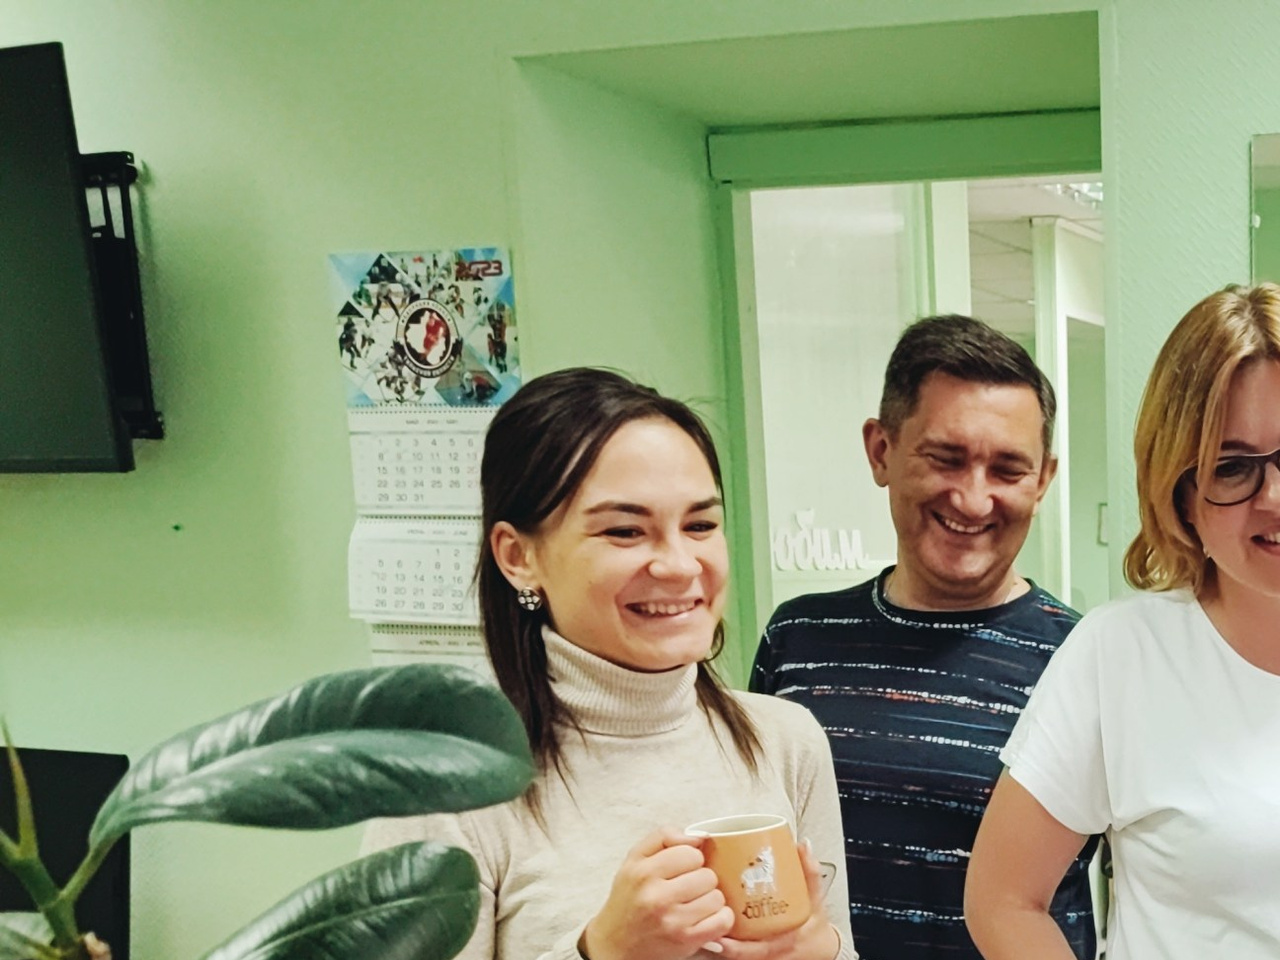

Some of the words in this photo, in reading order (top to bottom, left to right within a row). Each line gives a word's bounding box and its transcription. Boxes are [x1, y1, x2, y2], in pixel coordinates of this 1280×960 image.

[412, 453, 423, 461] 10
[430, 453, 440, 461] 11
[449, 453, 459, 461] 12
[377, 466, 388, 474] 15
[431, 466, 442, 474] 18
[449, 466, 460, 474] 19
[377, 480, 388, 488] 22
[413, 480, 425, 488] 24
[430, 480, 443, 488] 25
[743, 896, 788, 919] coffee
